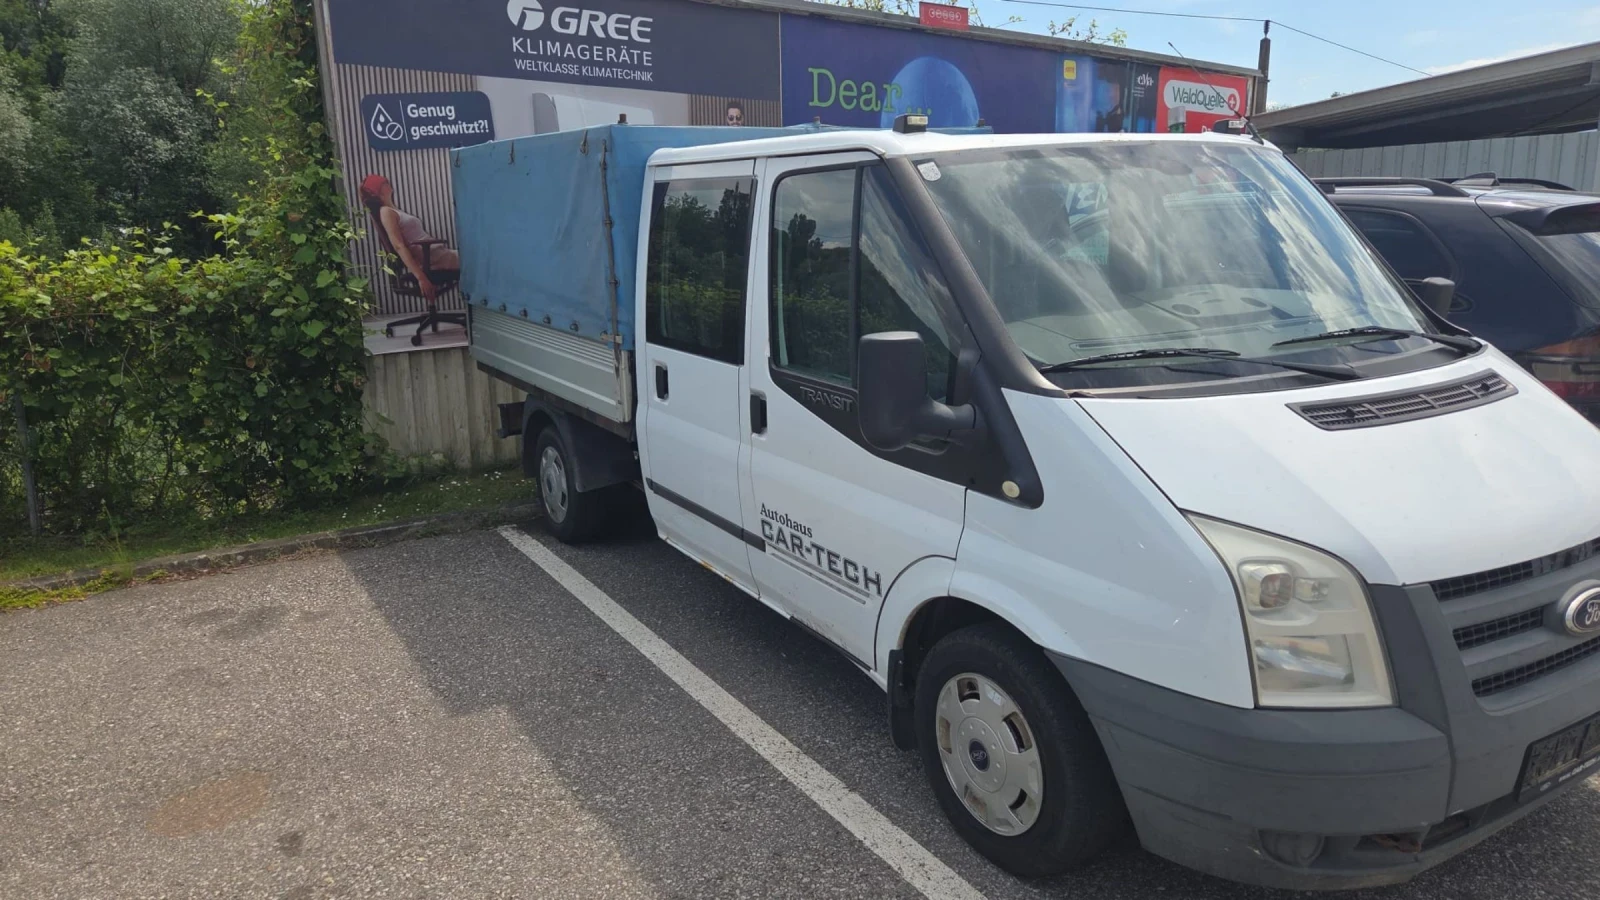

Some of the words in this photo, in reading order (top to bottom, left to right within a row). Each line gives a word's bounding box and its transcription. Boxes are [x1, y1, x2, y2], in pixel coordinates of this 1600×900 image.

[550, 6, 653, 43] GREE
[512, 36, 653, 66] KLIMAGERÄTE
[514, 58, 580, 76] WELTKLASSE
[581, 65, 654, 82] KLIMATECHNIK
[407, 103, 456, 120] Genug
[1172, 86, 1226, 111] WaldQuelle
[410, 119, 490, 140] geschwitzt?!
[800, 386, 853, 412] TRANSIT
[760, 503, 813, 538] Autohaus
[760, 518, 882, 597] CAR-TECH
